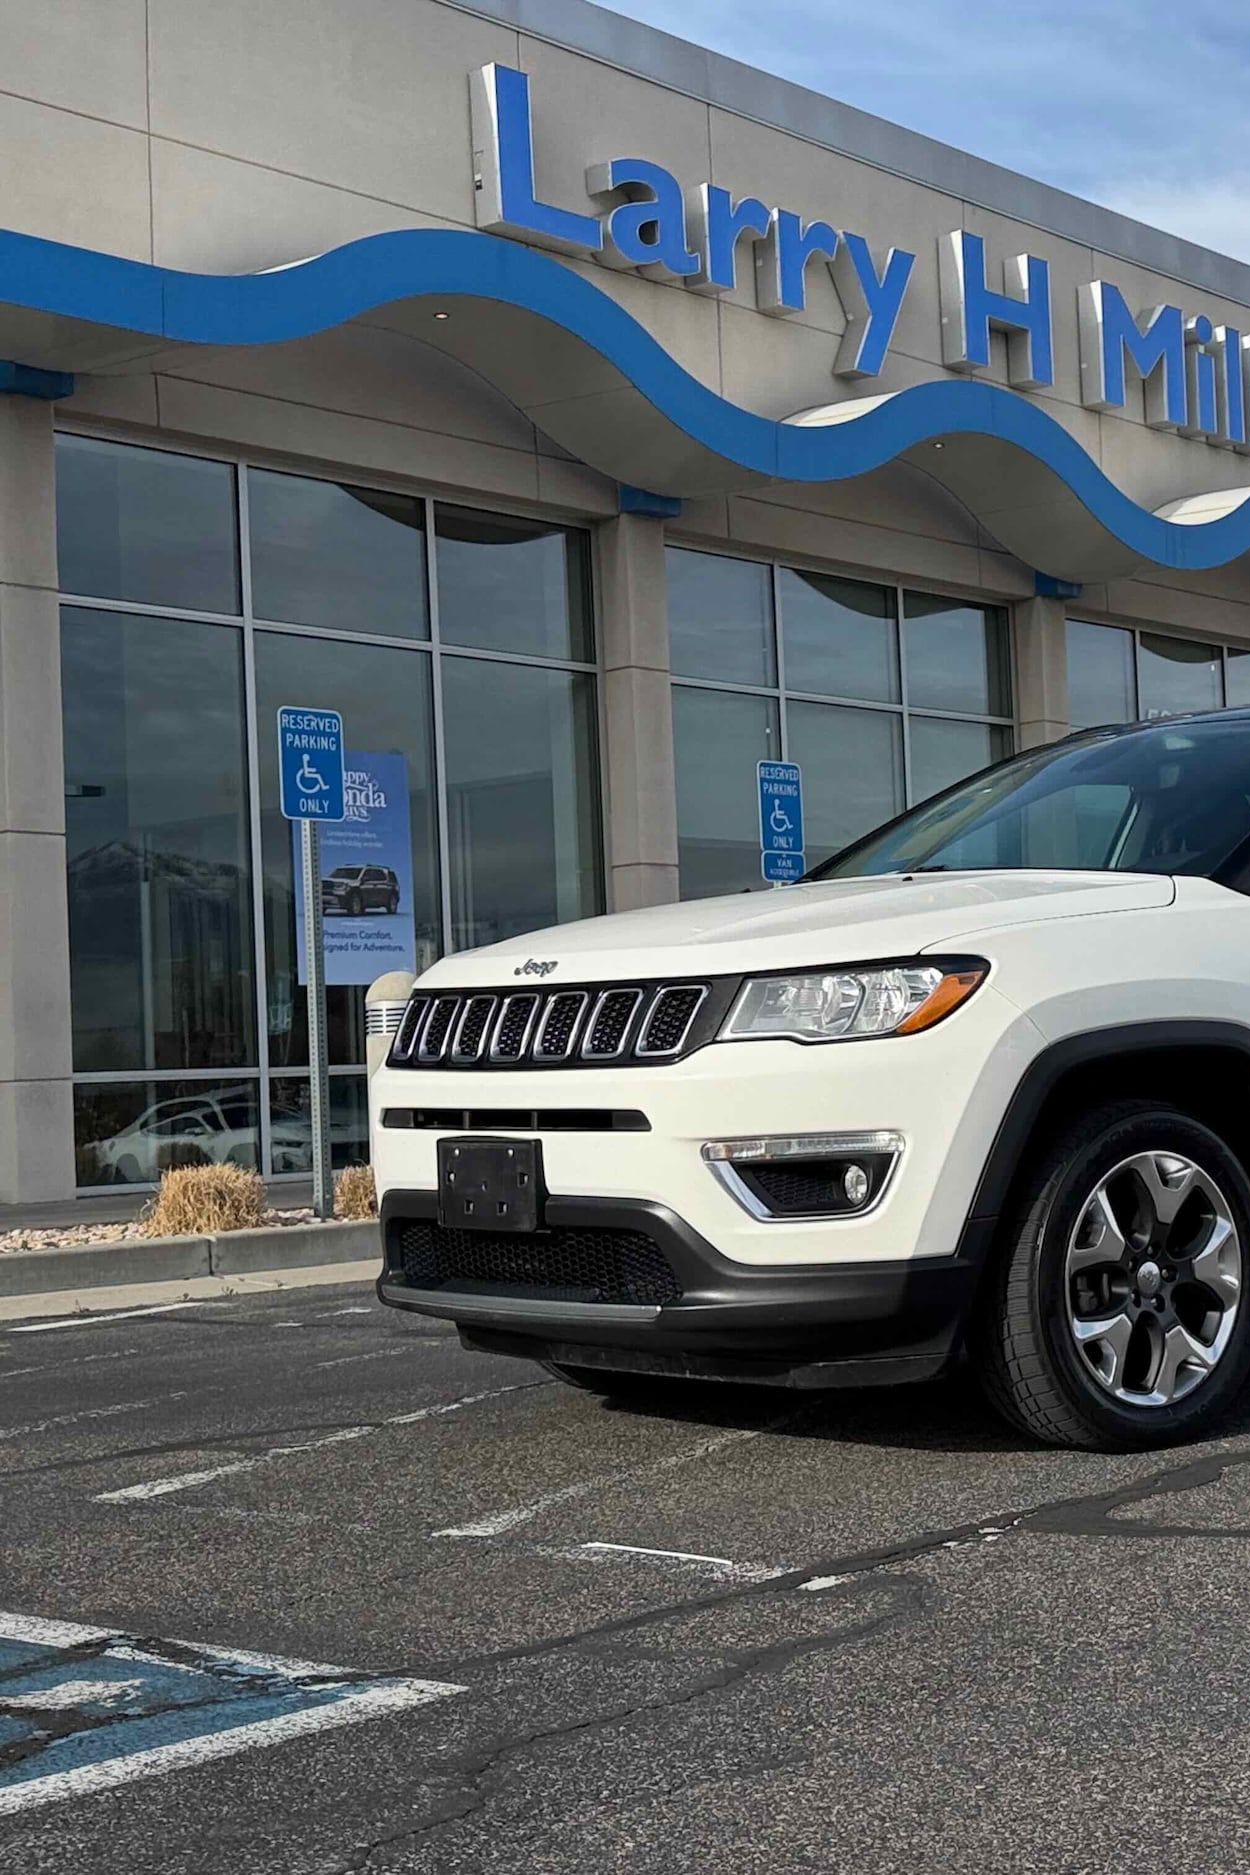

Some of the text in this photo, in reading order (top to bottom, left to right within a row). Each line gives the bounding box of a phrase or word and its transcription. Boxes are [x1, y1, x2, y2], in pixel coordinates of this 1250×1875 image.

[482, 62, 916, 377] Larry
[952, 229, 1053, 388] H
[281, 714, 340, 732] RESERVED
[286, 733, 336, 751] PARKING
[344, 771, 371, 785] ppy
[760, 766, 799, 781] RESERVED
[344, 782, 387, 808] nda
[763, 782, 798, 796] PARKING
[300, 798, 329, 813] ONLY
[773, 835, 794, 848] ONLY
[513, 958, 558, 977] Jeep
